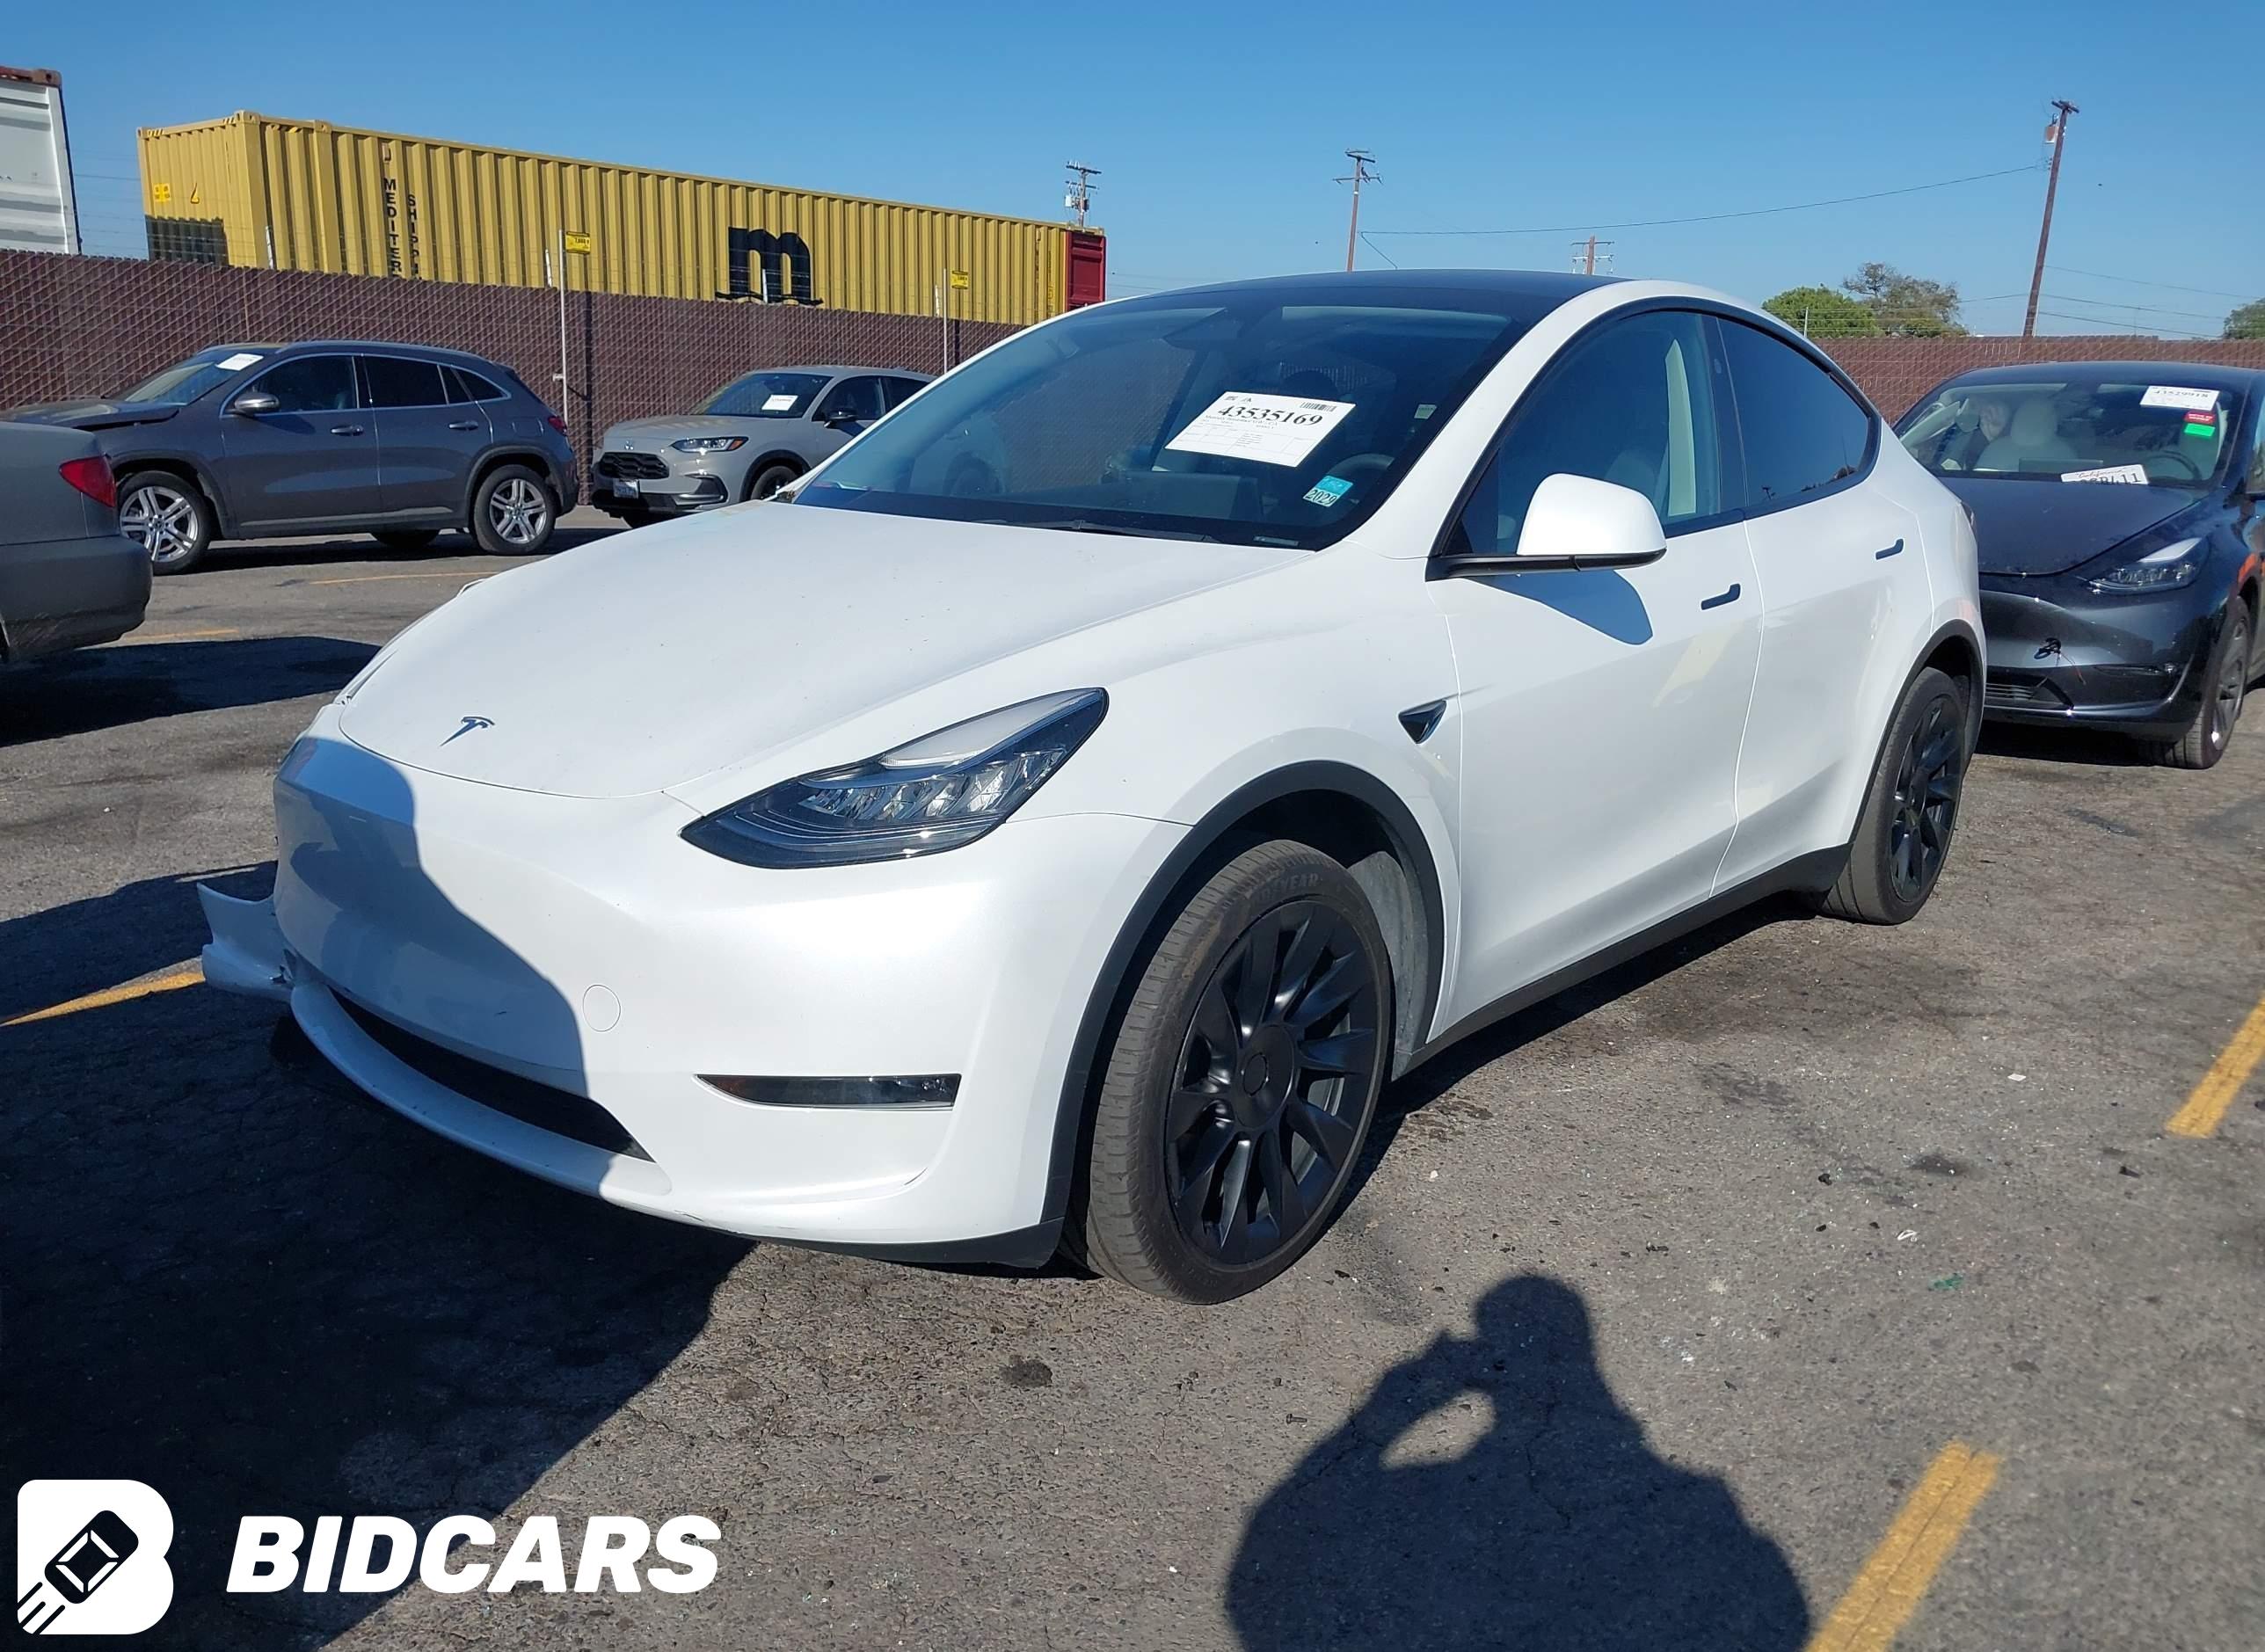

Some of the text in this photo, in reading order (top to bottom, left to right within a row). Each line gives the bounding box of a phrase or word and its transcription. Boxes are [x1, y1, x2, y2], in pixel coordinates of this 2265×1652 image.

[383, 178, 402, 279] MEDITER
[1218, 405, 1323, 426] 43535169
[1305, 489, 1337, 506] 2029
